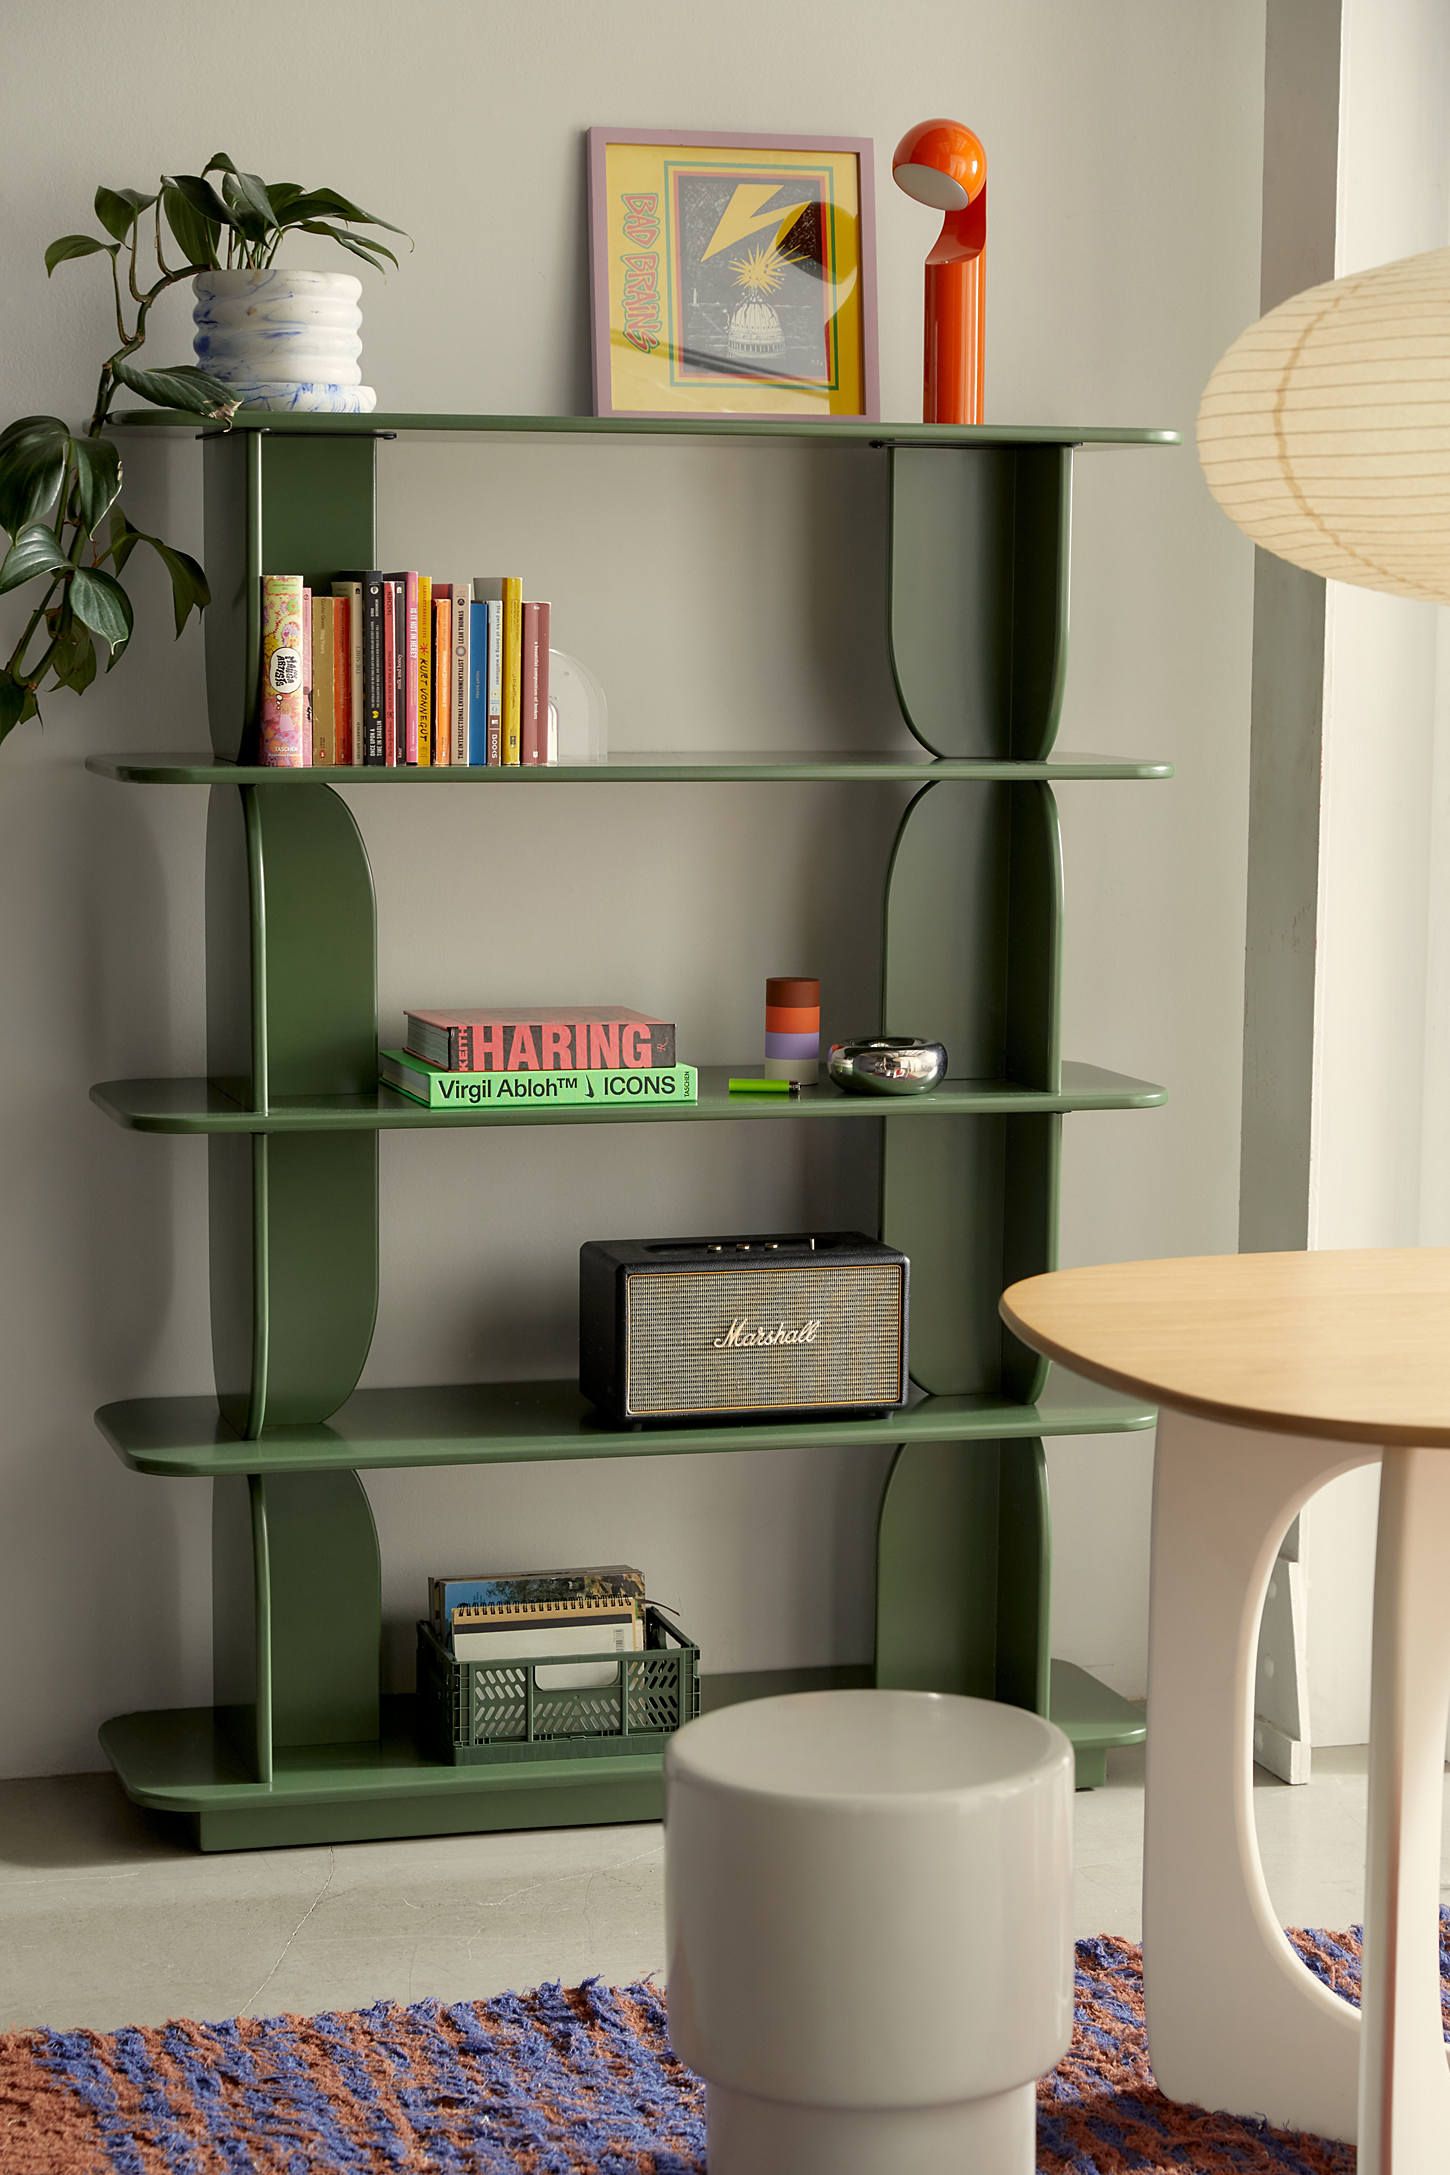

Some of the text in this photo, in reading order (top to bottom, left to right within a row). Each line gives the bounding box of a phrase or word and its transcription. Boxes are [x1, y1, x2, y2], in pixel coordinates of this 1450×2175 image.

[620, 193, 662, 354] BAD BRAINS
[409, 621, 417, 632] HOT
[409, 640, 417, 659] HERE?
[274, 655, 288, 687] ARTISTS
[419, 658, 428, 742] KURT VONNEGUT
[458, 1025, 472, 1072] KEITH
[472, 1023, 653, 1071] HARING
[438, 1079, 492, 1103] Virgil
[604, 1075, 676, 1096] ICONS
[713, 1318, 821, 1349] Marshall
